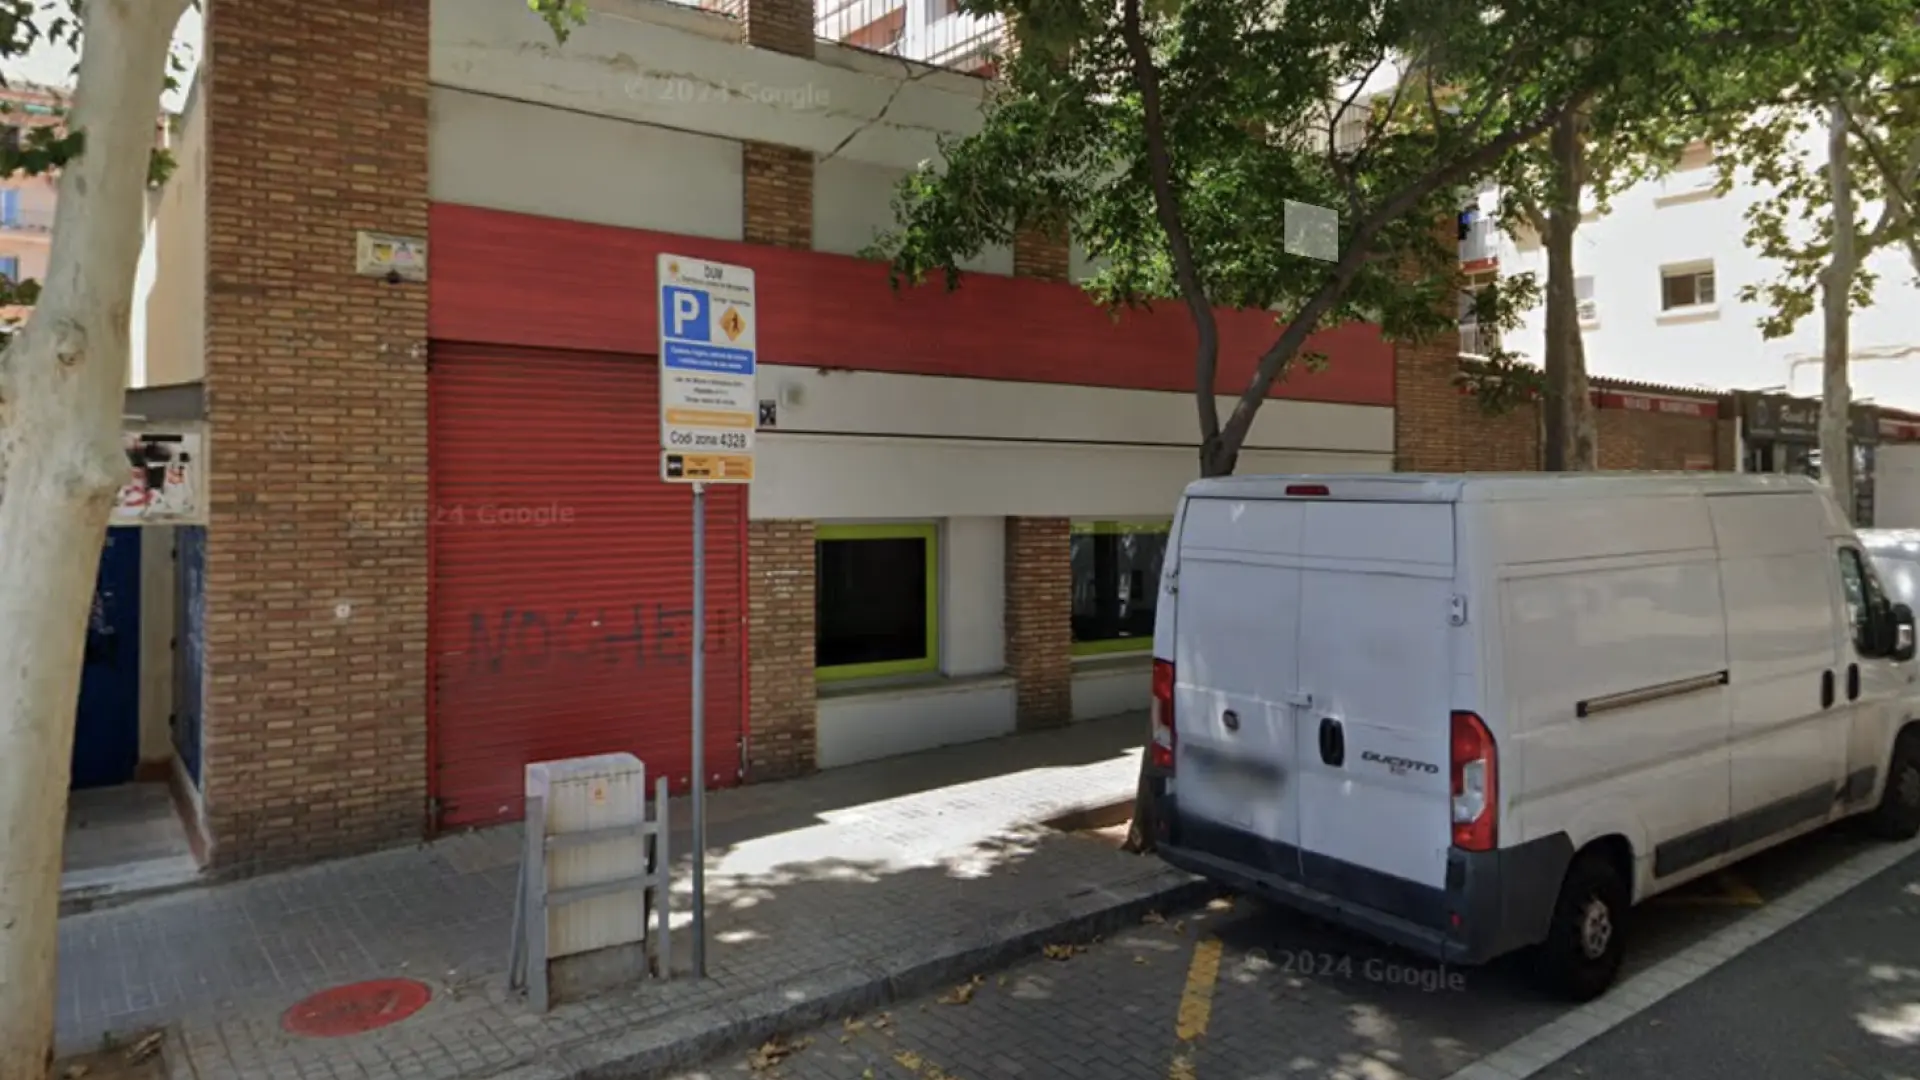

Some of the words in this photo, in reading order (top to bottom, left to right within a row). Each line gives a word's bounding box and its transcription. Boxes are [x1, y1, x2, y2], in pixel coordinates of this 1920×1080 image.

[673, 290, 700, 336] P
[669, 428, 693, 445] Codi
[695, 434, 718, 446] zona
[1361, 750, 1439, 774] DUCATO
